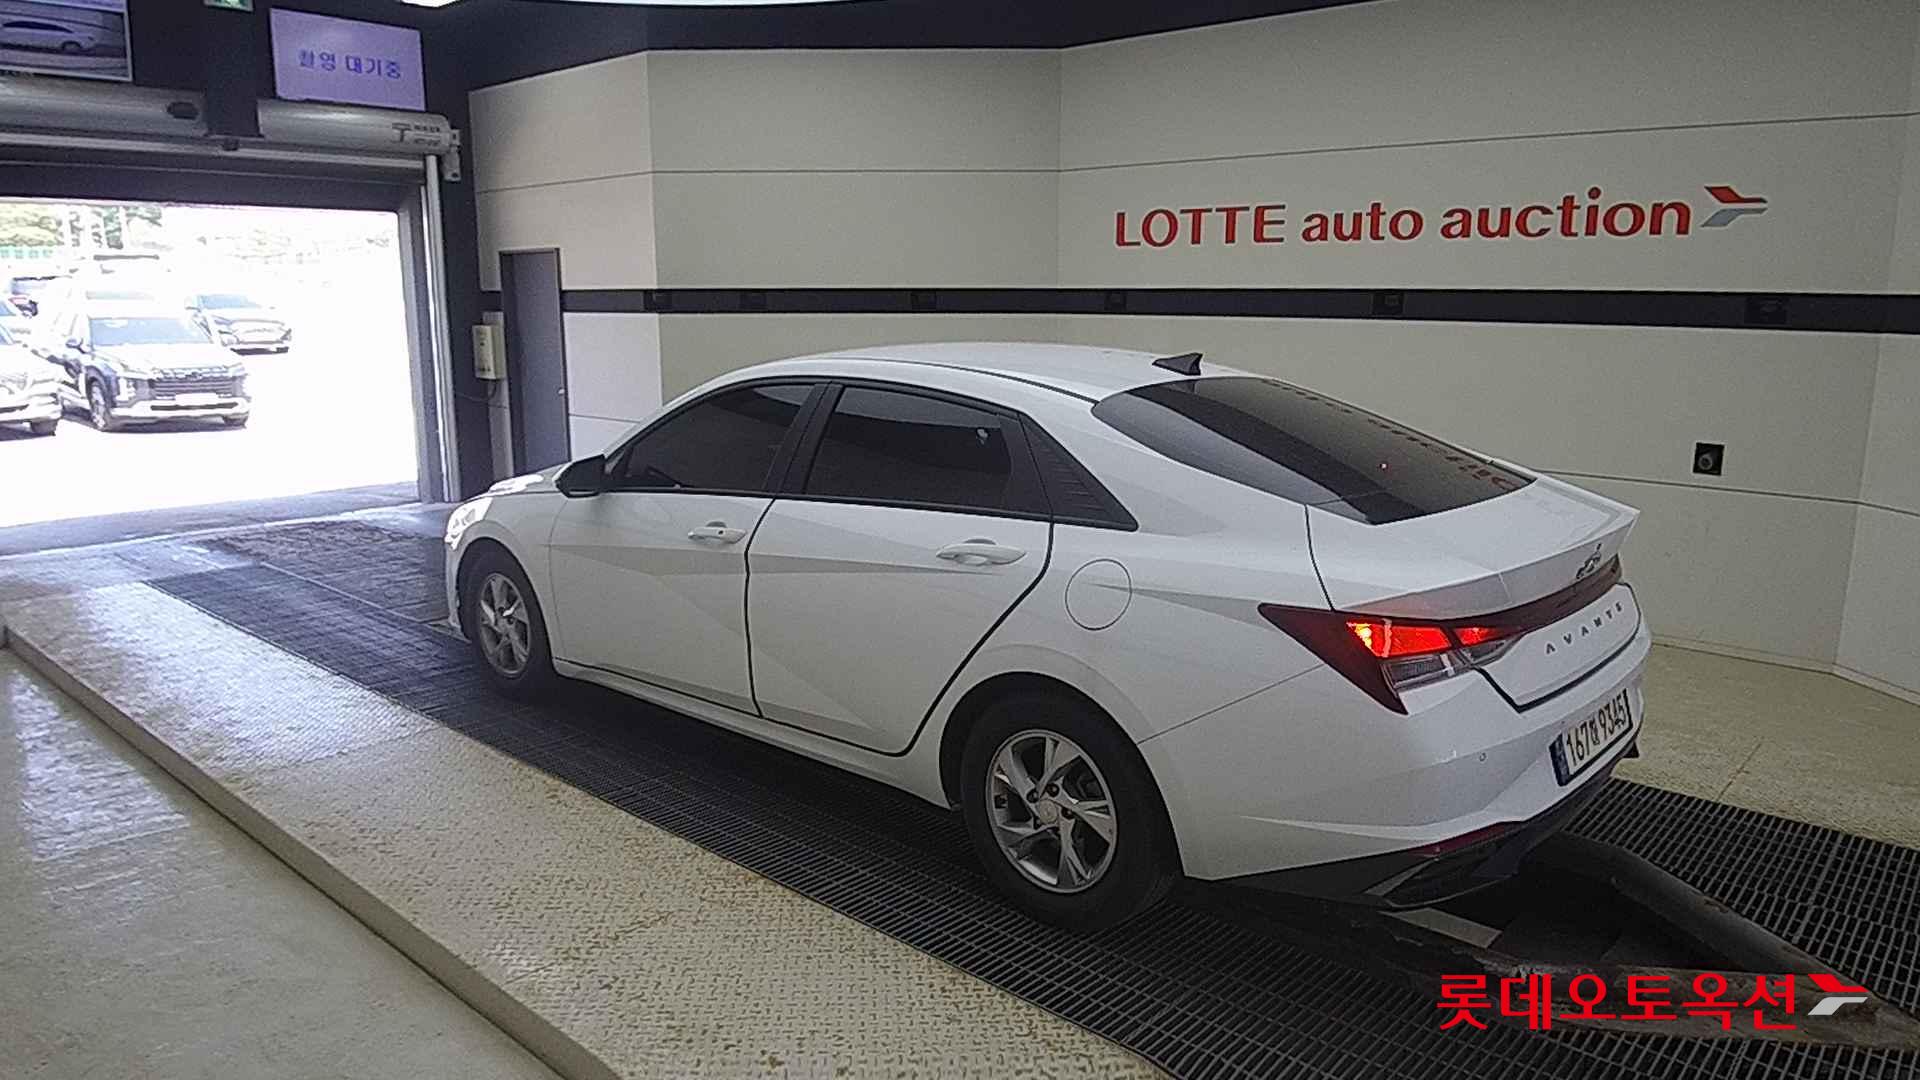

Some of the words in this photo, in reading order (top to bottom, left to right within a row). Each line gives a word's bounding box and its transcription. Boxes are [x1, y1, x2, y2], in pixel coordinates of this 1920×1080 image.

[345, 54, 401, 79] 대기중
[1116, 205, 1286, 247] LOTTE
[1302, 202, 1424, 241] auto
[1440, 187, 1691, 239] auction
[1545, 602, 1623, 655] AVANTE
